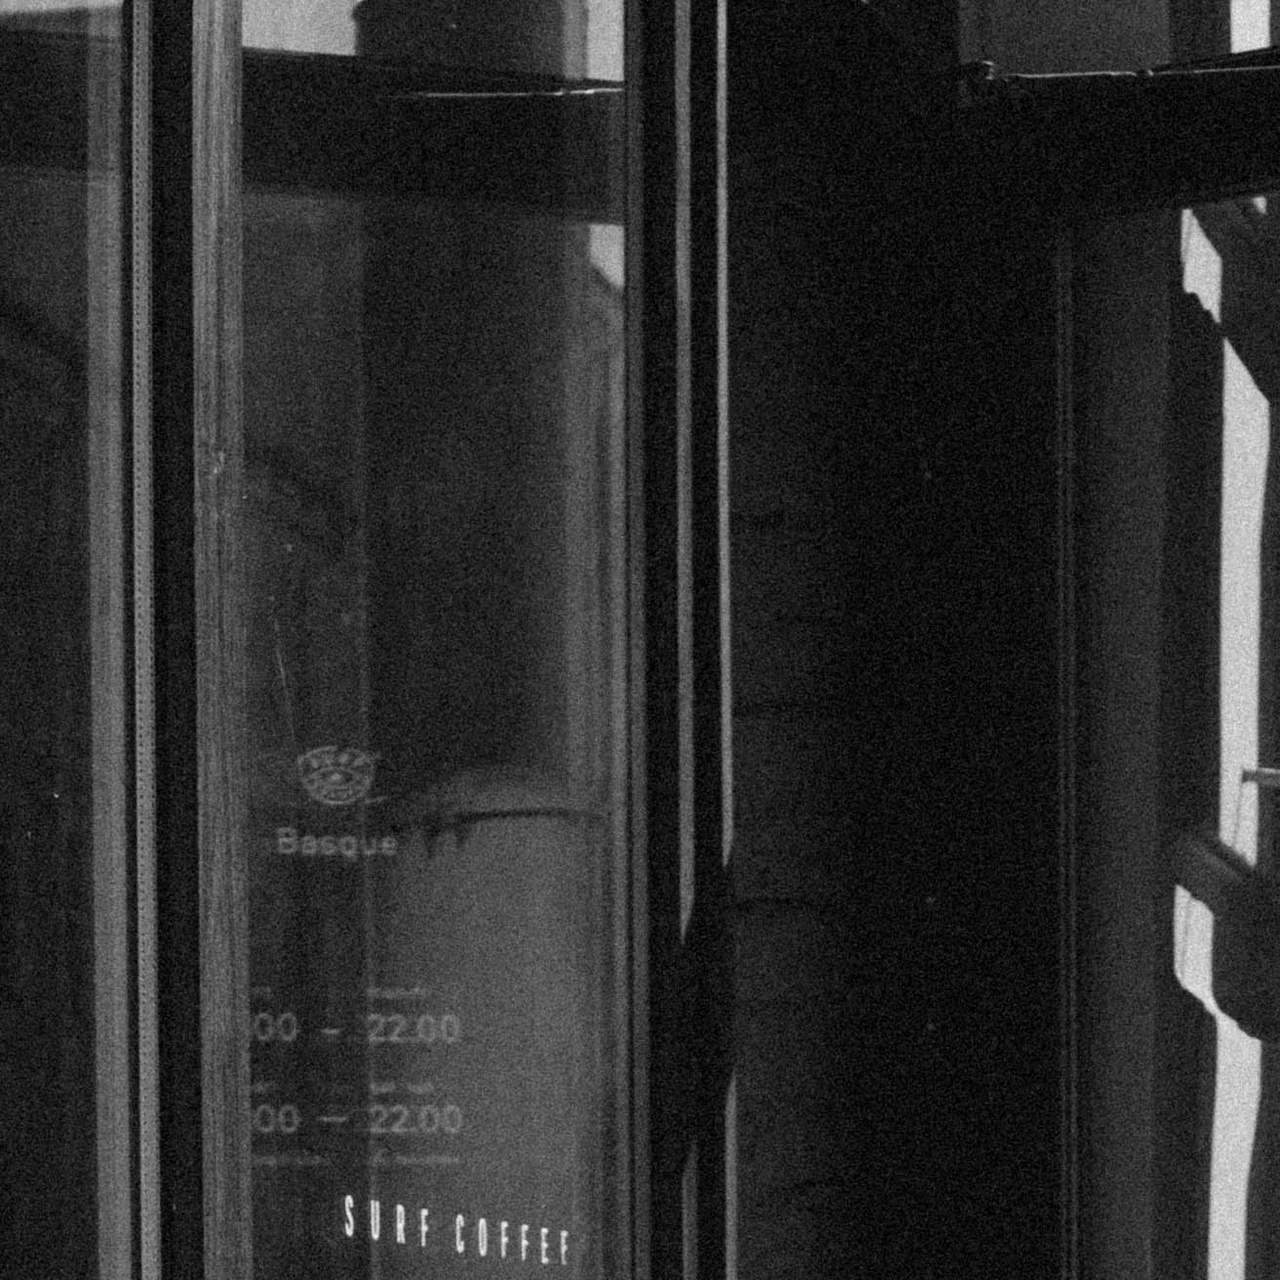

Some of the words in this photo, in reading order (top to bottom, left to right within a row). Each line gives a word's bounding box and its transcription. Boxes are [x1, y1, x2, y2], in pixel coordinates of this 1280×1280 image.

[276, 826, 399, 859] Basque
[253, 1012, 299, 1043] 00
[366, 1012, 462, 1044] 22.00
[253, 1104, 300, 1134] 00
[368, 1104, 463, 1134] 22.00
[343, 1193, 430, 1248] SURF
